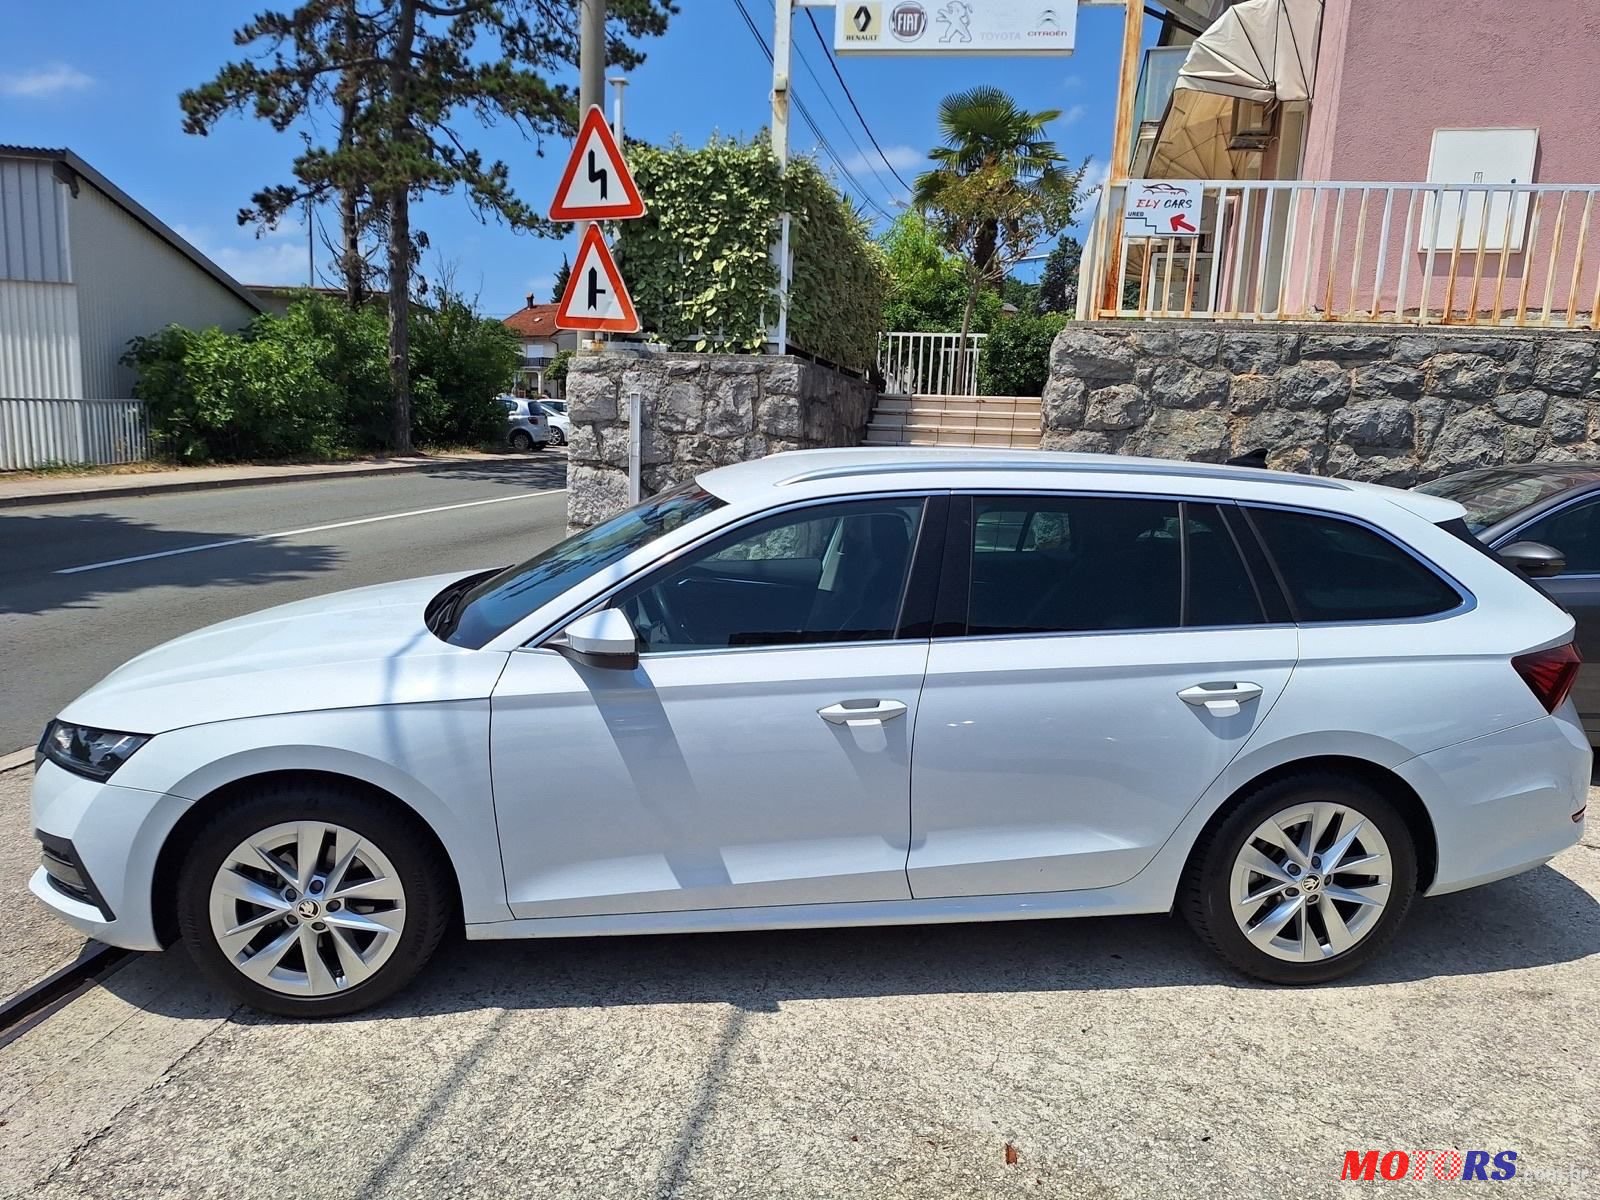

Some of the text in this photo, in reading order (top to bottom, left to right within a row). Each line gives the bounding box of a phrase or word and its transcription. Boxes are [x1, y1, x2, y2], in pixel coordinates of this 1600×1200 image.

[897, 13, 920, 32] FIAT
[980, 32, 1021, 40] TOYOTA
[1136, 199, 1192, 209] ELY CARS
